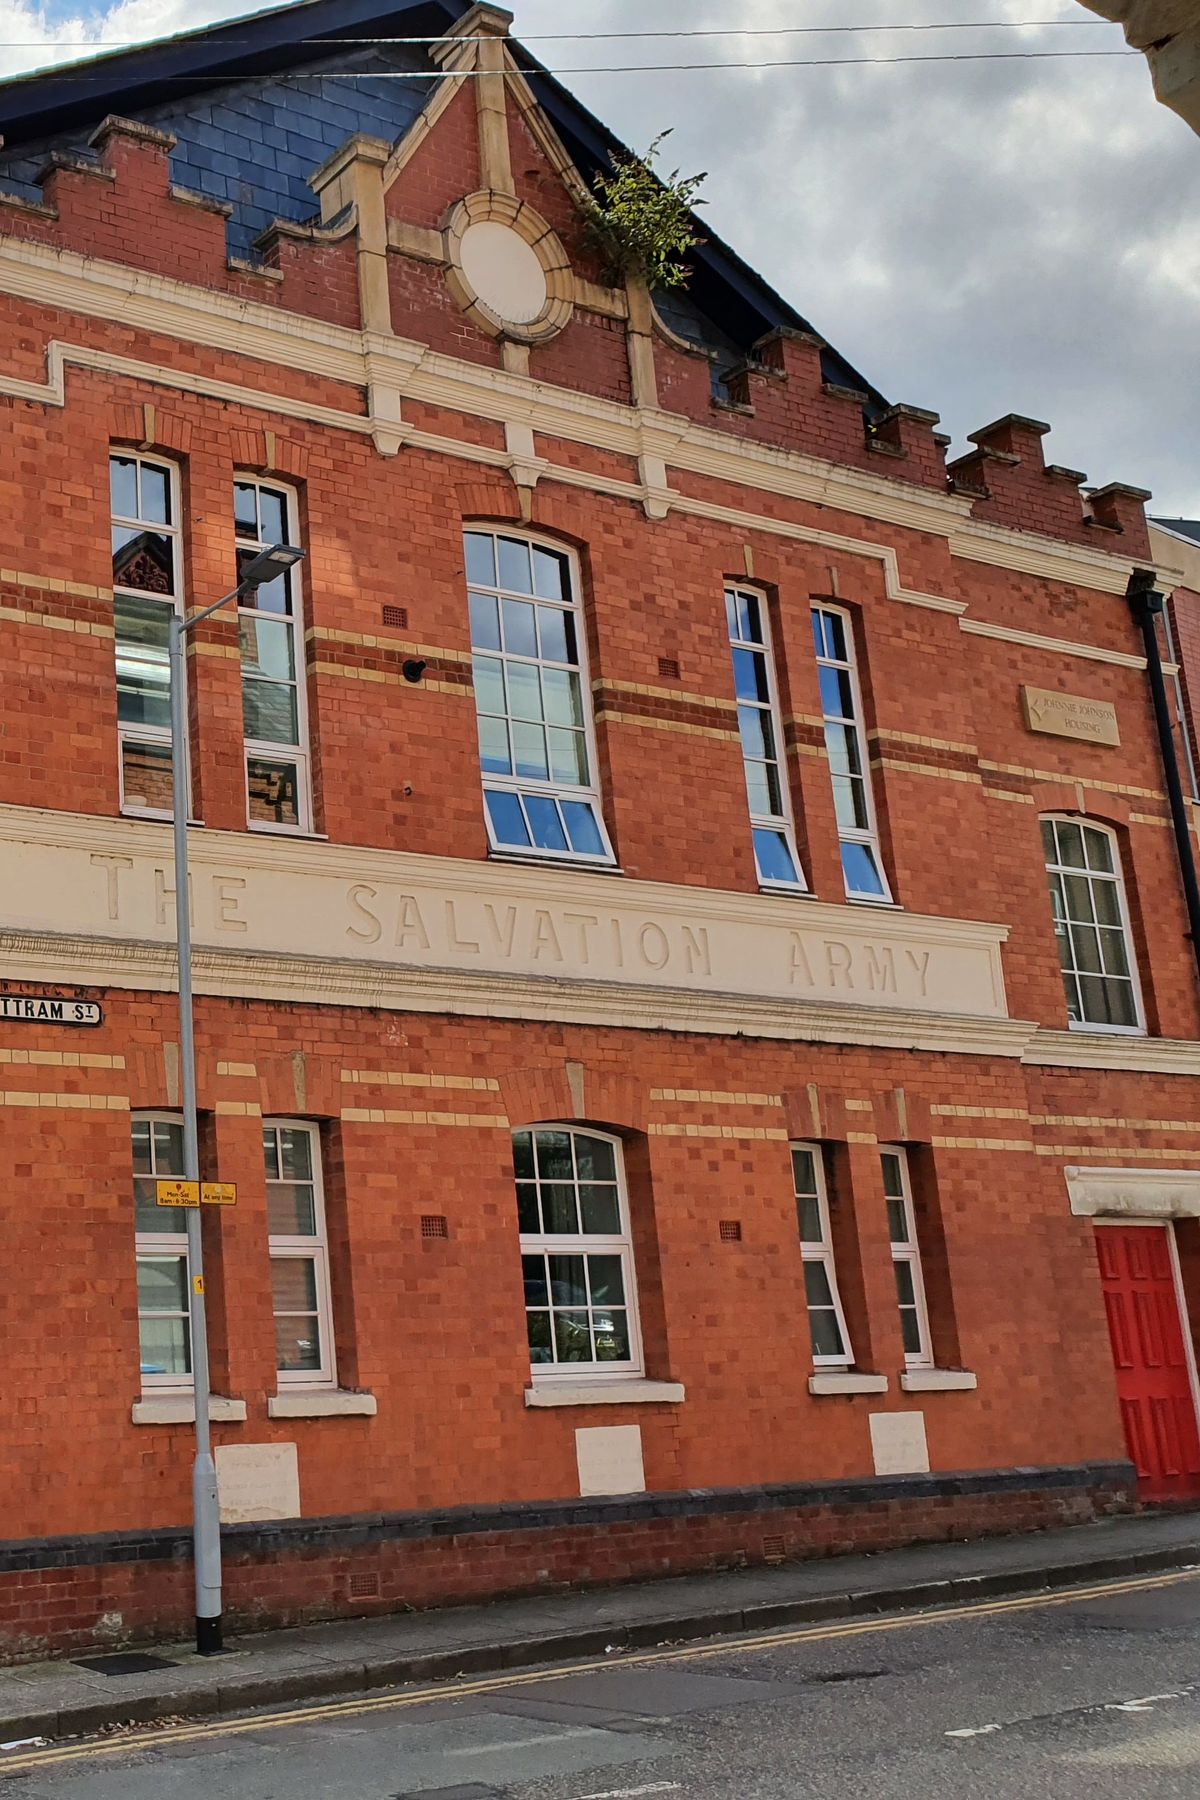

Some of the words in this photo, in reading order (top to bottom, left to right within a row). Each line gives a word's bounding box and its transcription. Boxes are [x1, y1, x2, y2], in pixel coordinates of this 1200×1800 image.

[1064, 718, 1101, 733] HOUSING
[90, 853, 248, 932] THE
[345, 884, 712, 976] SALVATION
[789, 930, 929, 996] ARMY
